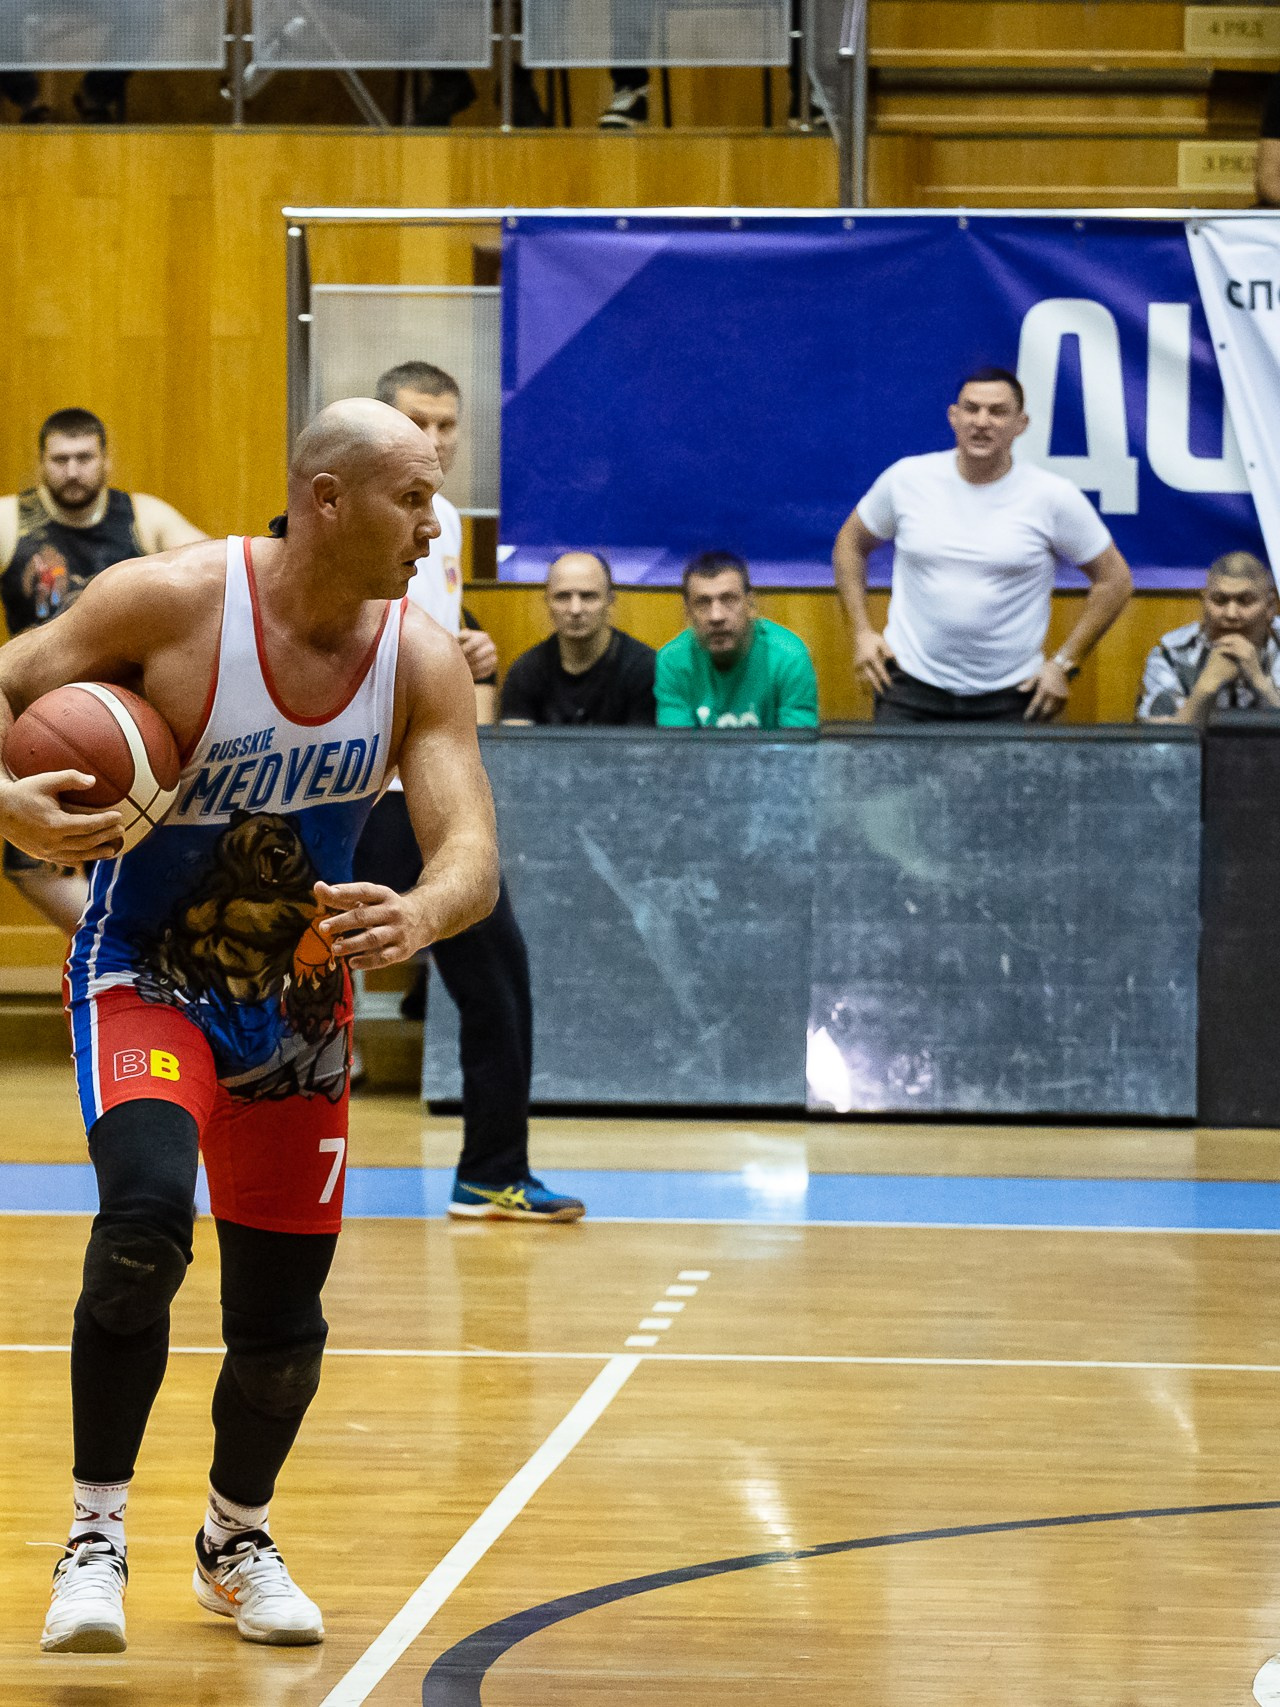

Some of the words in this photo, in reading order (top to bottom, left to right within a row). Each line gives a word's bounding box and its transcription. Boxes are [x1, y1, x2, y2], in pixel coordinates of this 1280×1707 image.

[205, 727, 276, 763] RUSSKIE
[177, 733, 380, 816] MEDVEDI
[113, 1049, 181, 1082] BB
[319, 1138, 345, 1204] 7
